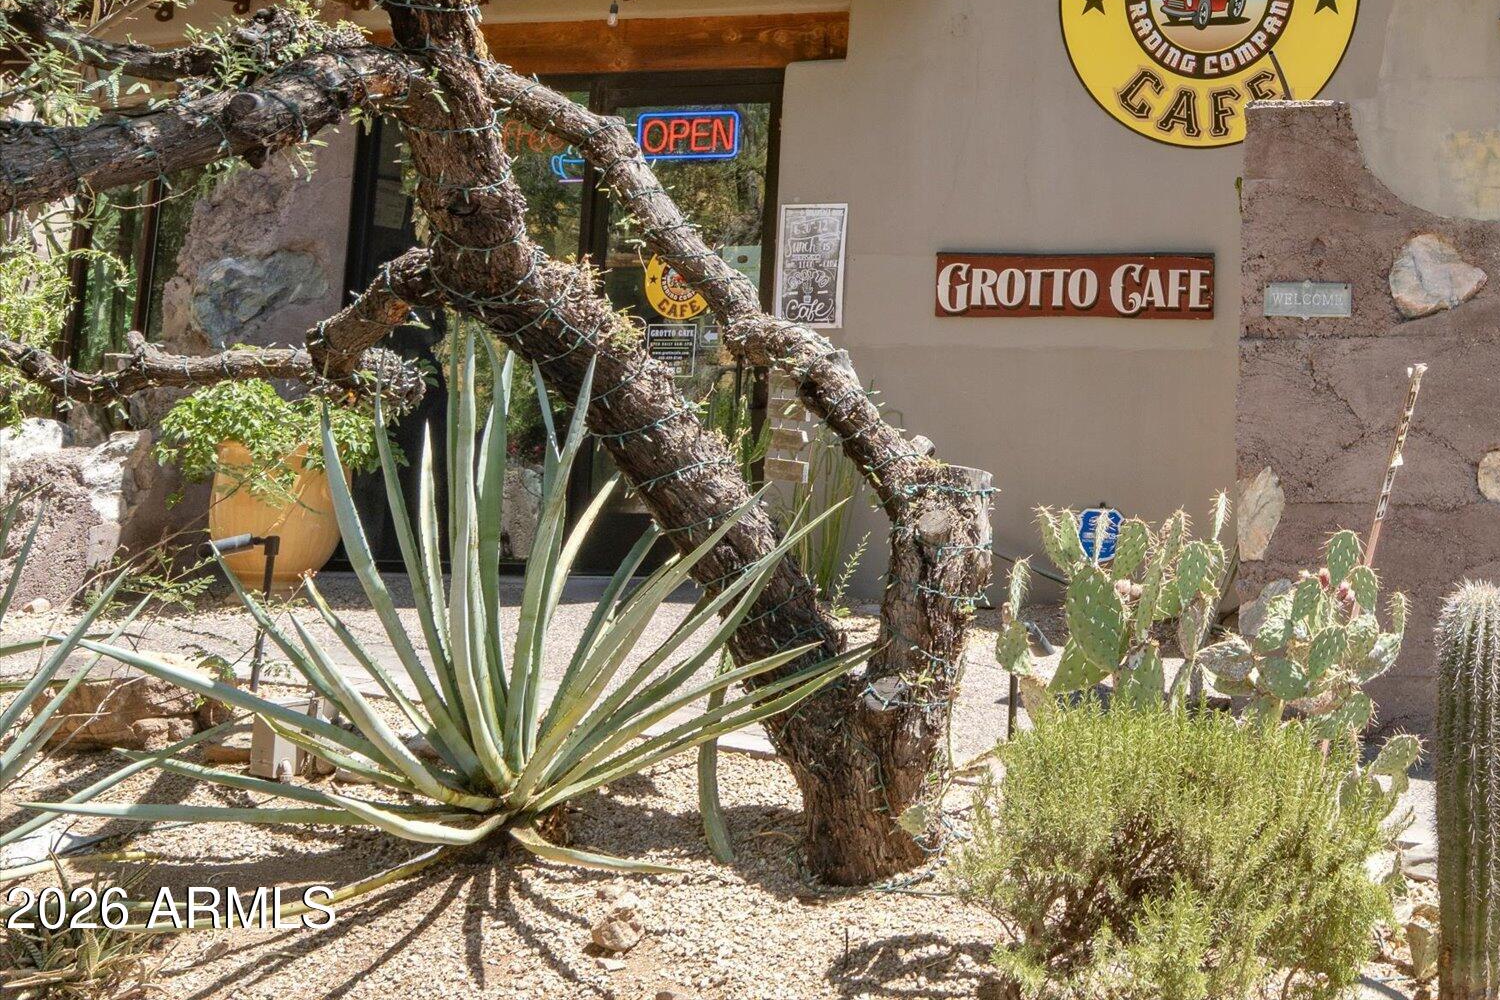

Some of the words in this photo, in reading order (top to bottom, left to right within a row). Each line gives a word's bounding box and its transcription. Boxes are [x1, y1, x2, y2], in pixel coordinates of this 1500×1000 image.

[642, 117, 735, 154] OPEN
[937, 262, 1098, 314] GROTTO
[1109, 263, 1212, 315] CAFE
[657, 298, 701, 318] CAFE
[1271, 292, 1344, 306] WELCOME
[650, 329, 676, 338] GROTTO
